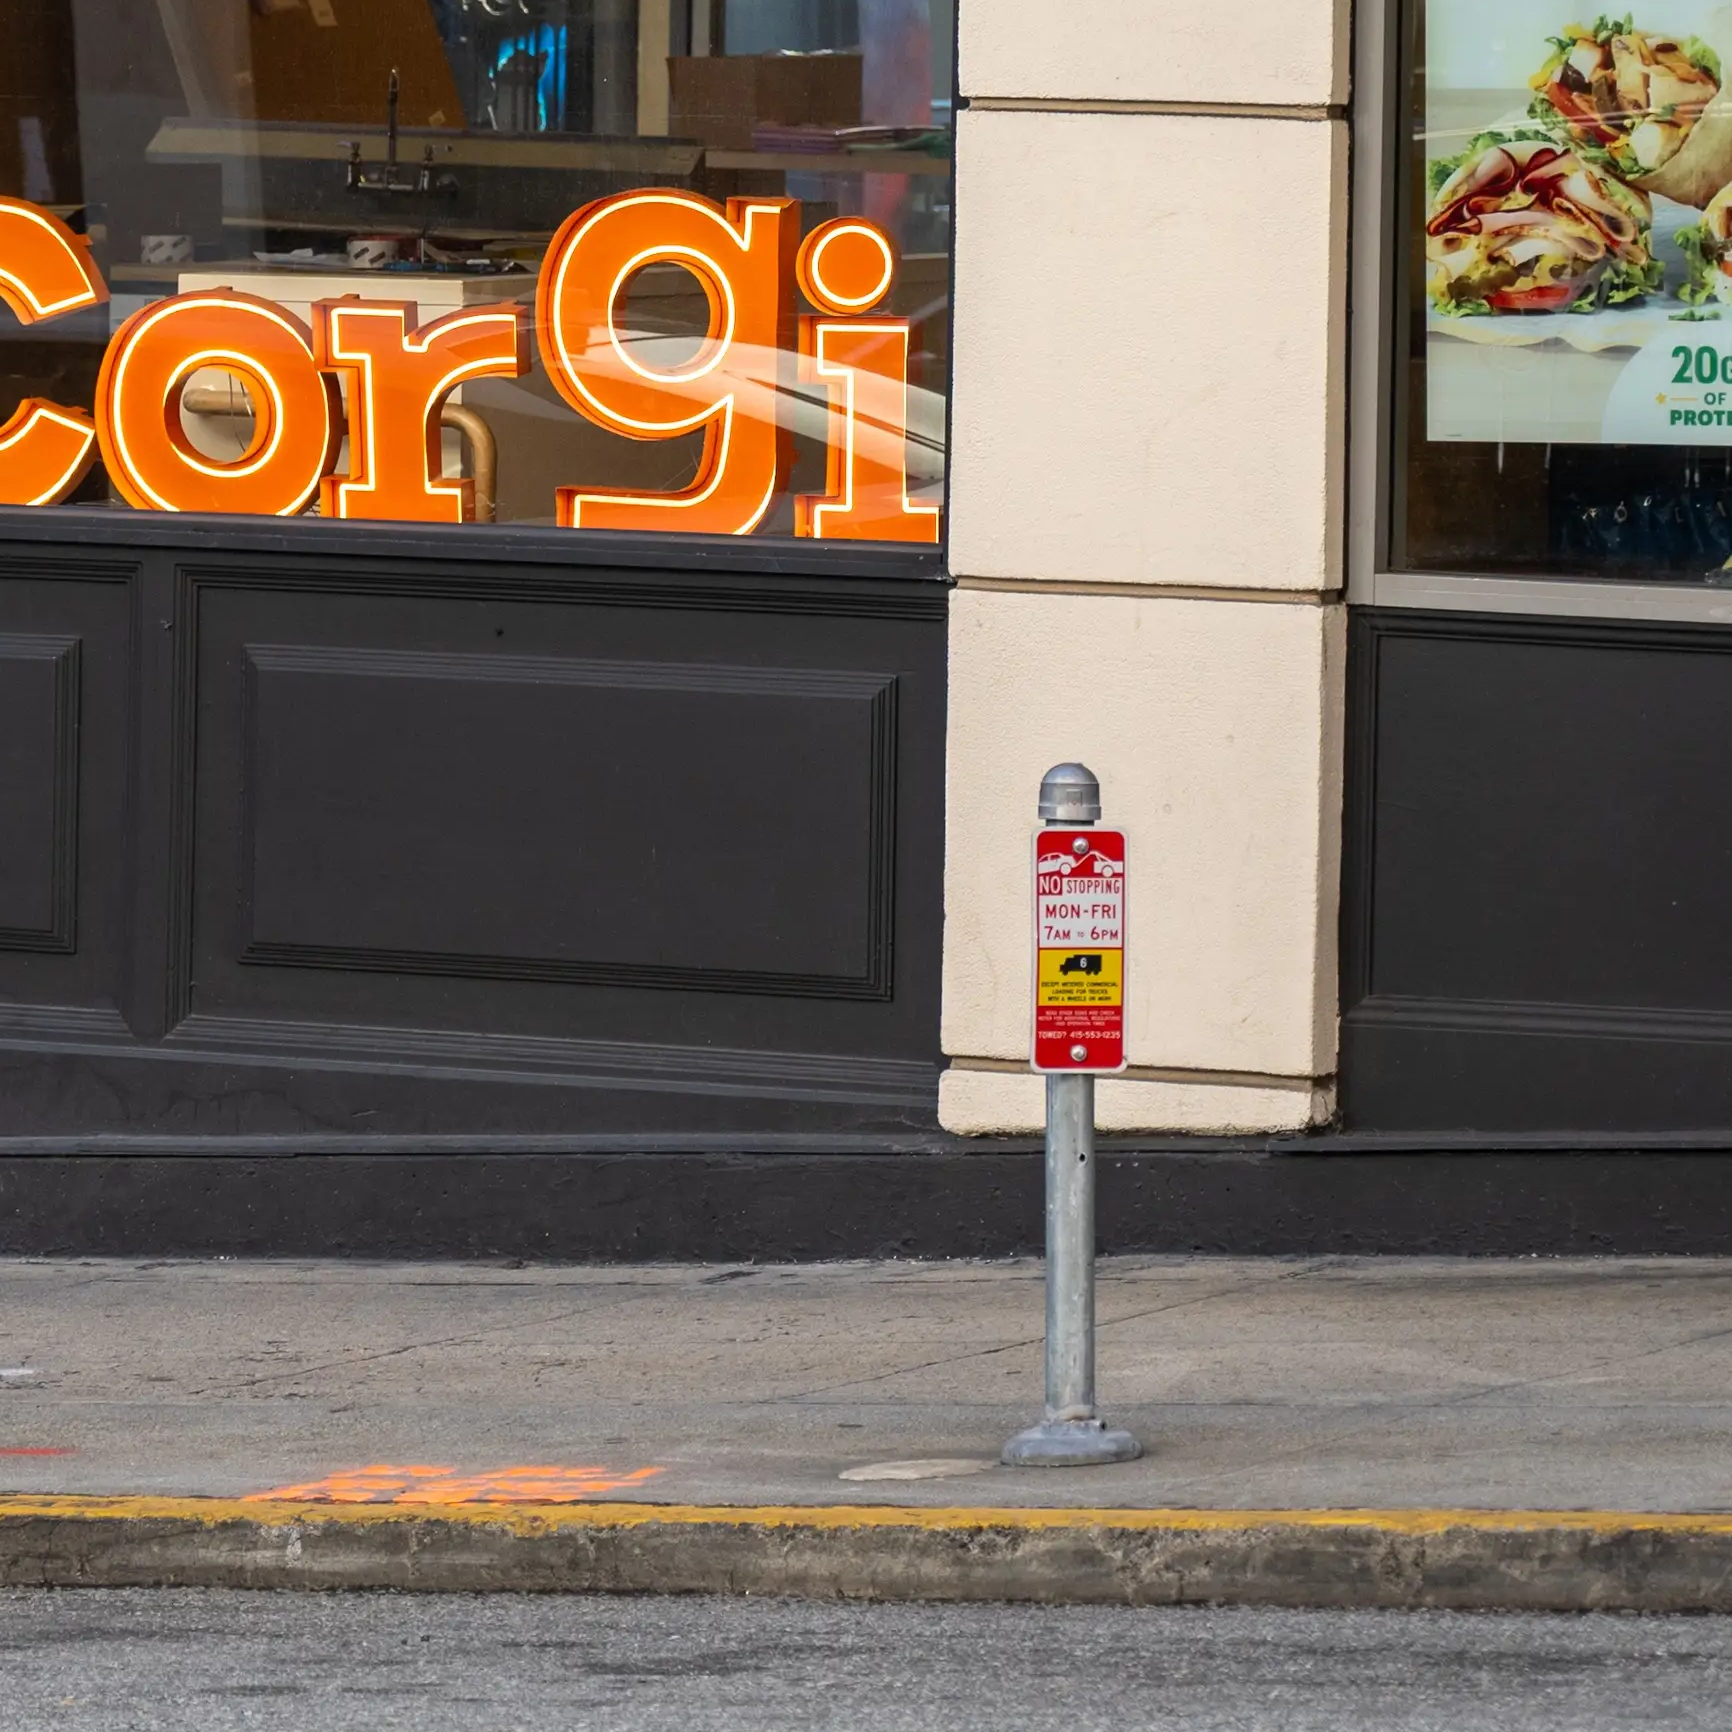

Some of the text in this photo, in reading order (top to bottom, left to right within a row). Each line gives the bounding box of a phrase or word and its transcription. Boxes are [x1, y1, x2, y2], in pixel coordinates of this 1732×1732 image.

[1704, 392, 1726, 405] OF
[1039, 875, 1120, 894] NO STOPPING
[1045, 904, 1116, 919] MON-FRI
[1044, 925, 1071, 940] 7AM
[1090, 925, 1119, 940] 6PM
[1080, 957, 1087, 968] 6
